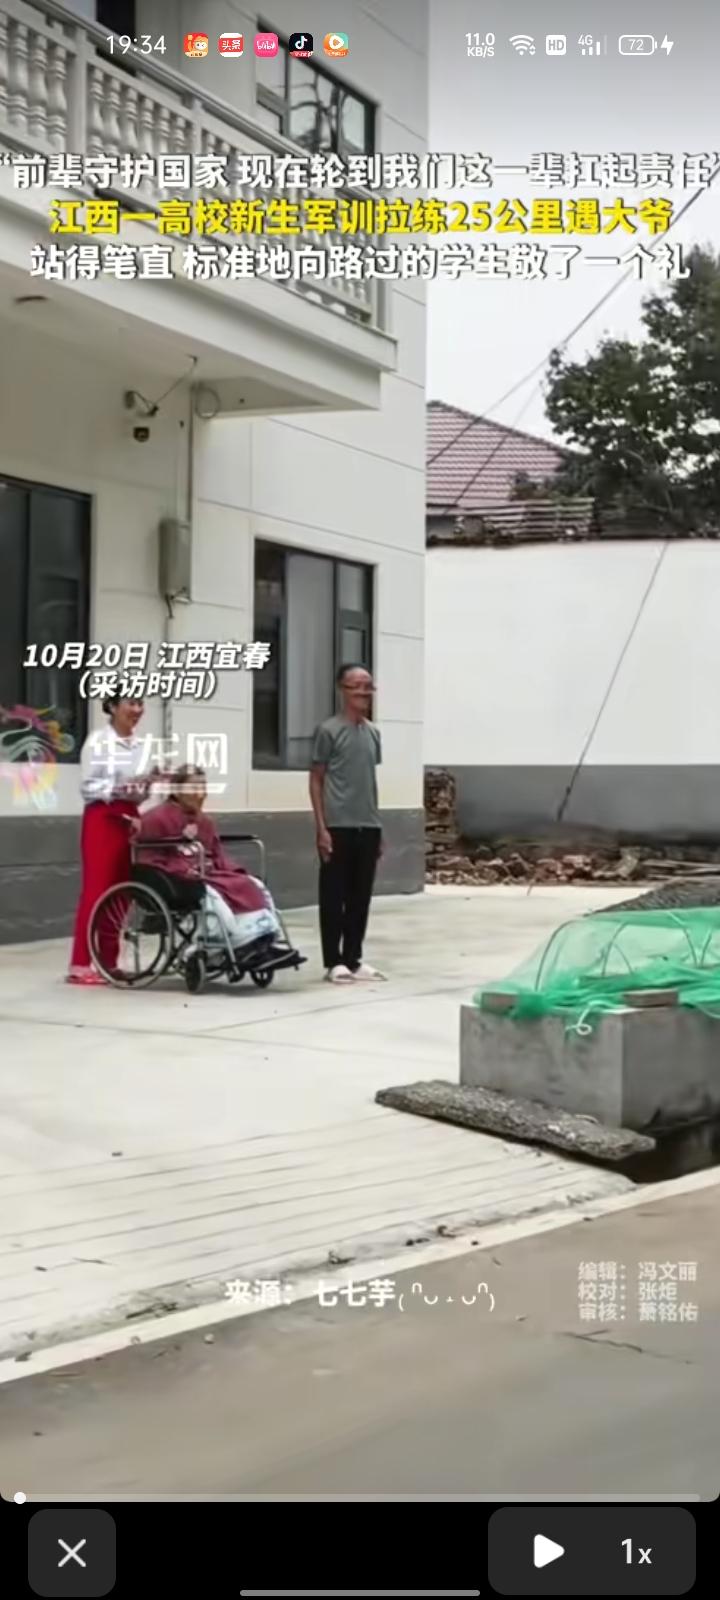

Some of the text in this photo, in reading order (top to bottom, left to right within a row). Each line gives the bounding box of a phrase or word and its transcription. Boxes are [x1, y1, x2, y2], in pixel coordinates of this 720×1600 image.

[106, 35, 167, 55] 19:34
[465, 32, 496, 47] 11.0
[548, 38, 565, 51] HD
[577, 35, 593, 46] 4G
[627, 39, 645, 51] 72
[466, 46, 495, 58] KB/S
[621, 1538, 653, 1564] 1x
